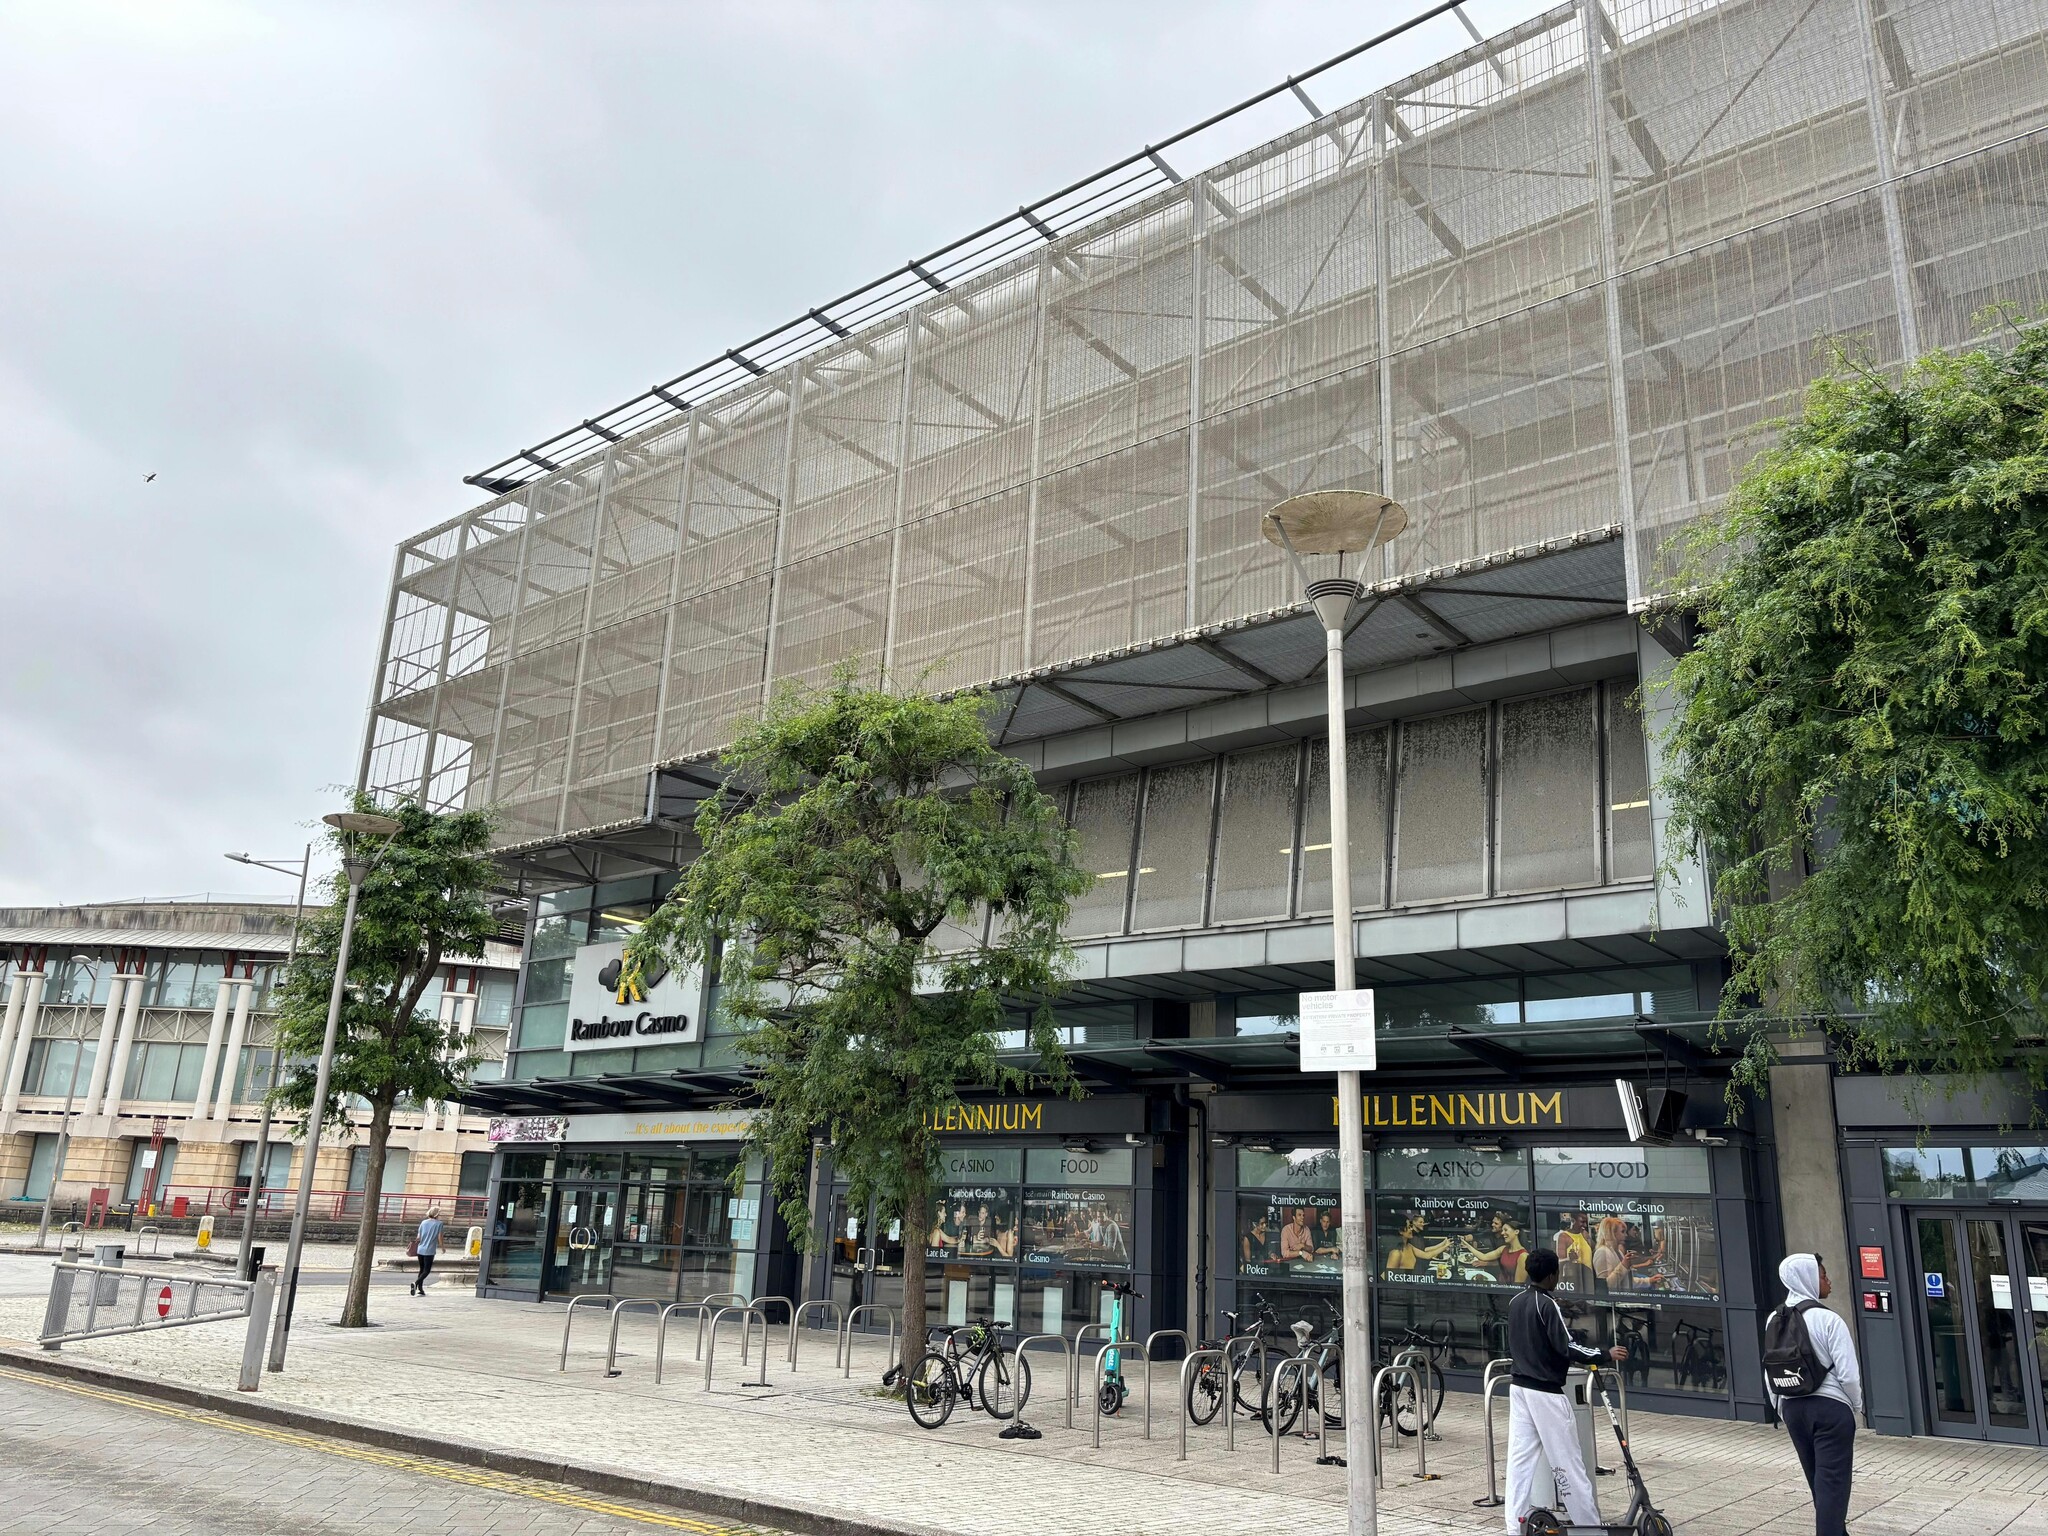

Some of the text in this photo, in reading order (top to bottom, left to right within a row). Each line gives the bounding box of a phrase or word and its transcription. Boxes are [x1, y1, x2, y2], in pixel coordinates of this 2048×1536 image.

[1301, 994, 1312, 1002] No
[1301, 1002, 1334, 1010] vehicles
[571, 1012, 688, 1041] Rainbow Casino
[651, 1122, 663, 1134] all
[664, 1122, 691, 1134] about
[693, 1121, 709, 1134] the
[950, 1159, 995, 1173] CASINO
[1060, 1159, 1099, 1174] FOOD
[1287, 1161, 1319, 1177] BAR
[1416, 1161, 1485, 1178] CASINO
[1588, 1162, 1649, 1178] FOOD
[975, 1188, 997, 1198] Casino
[1051, 1190, 1080, 1200] Rainbow
[1082, 1190, 1106, 1201] Casino
[1271, 1195, 1337, 1206] Rainbow Casino
[1414, 1197, 1490, 1210] Rainbow Casino
[1578, 1200, 1665, 1213] Rainbow Casino
[926, 1247, 950, 1258] Late Bar
[1028, 1253, 1050, 1263] Casino
[1246, 1264, 1269, 1275] Poker
[1388, 1271, 1435, 1284] Restaurant
[1555, 1281, 1575, 1291] lots
[1772, 1376, 1801, 1388] PUMA
